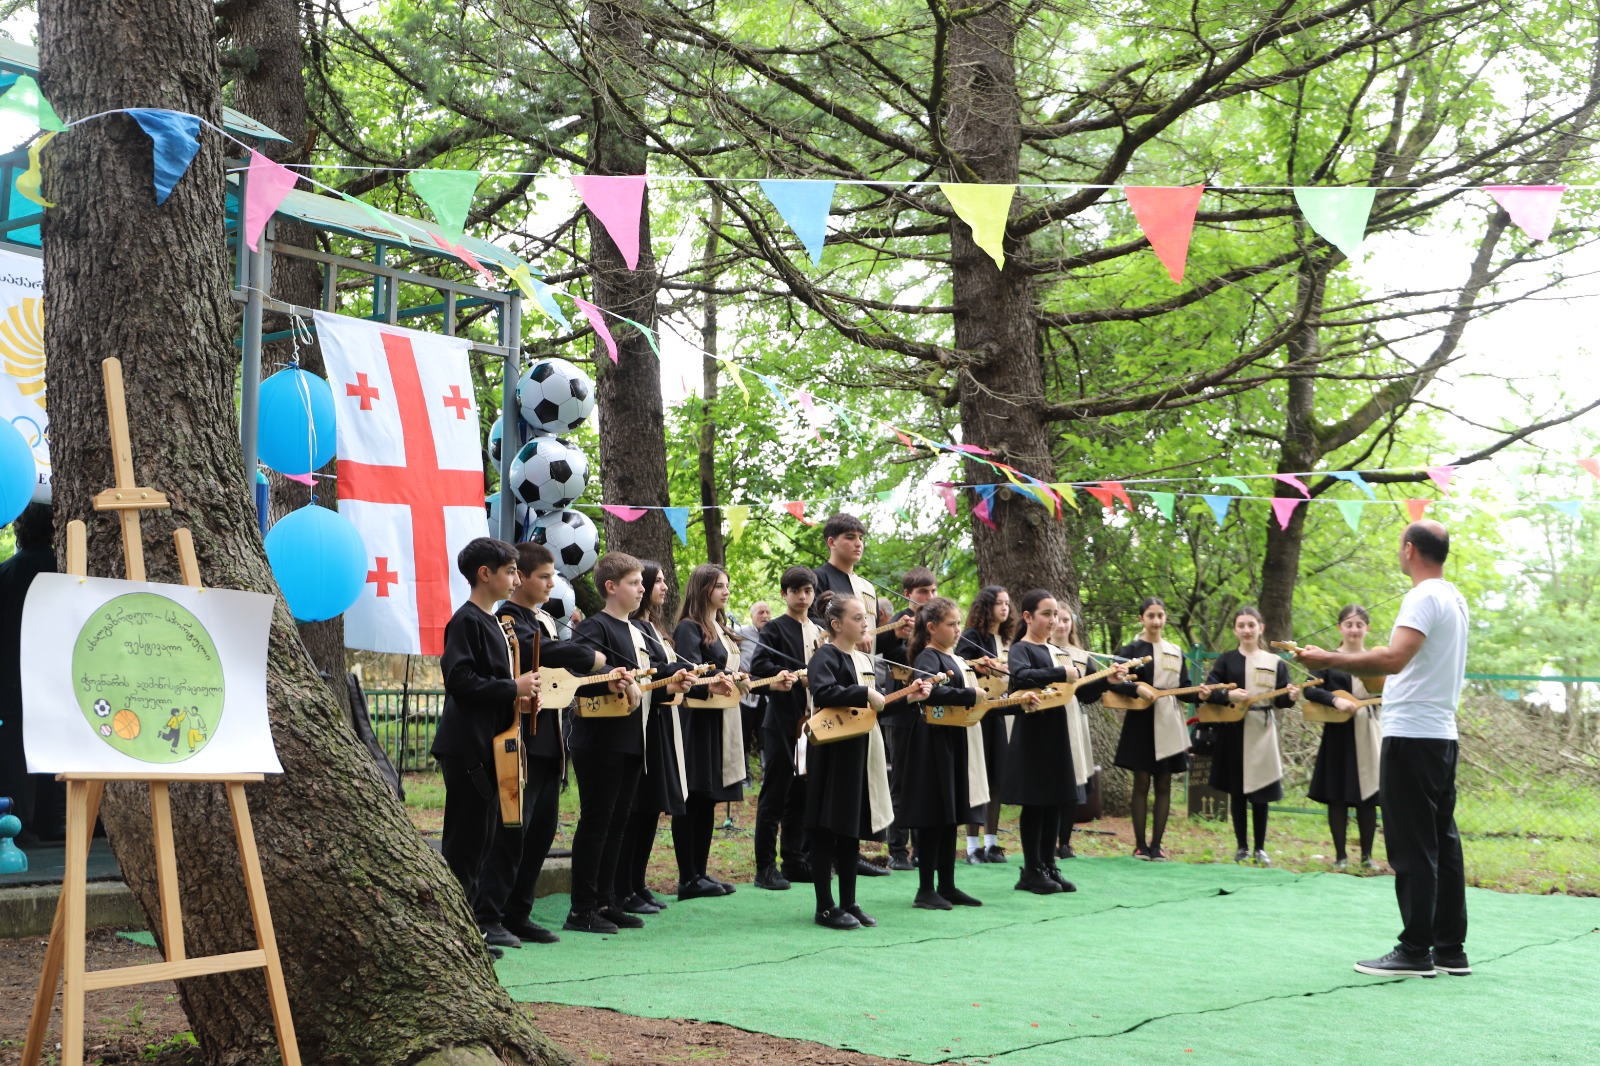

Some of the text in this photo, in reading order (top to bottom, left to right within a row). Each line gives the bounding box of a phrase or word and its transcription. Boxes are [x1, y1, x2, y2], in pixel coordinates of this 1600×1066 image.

[124, 633, 183, 657] ფესტივალი
[136, 676, 223, 698] ადმინისტრაციული
[124, 688, 173, 710] ერთეული
